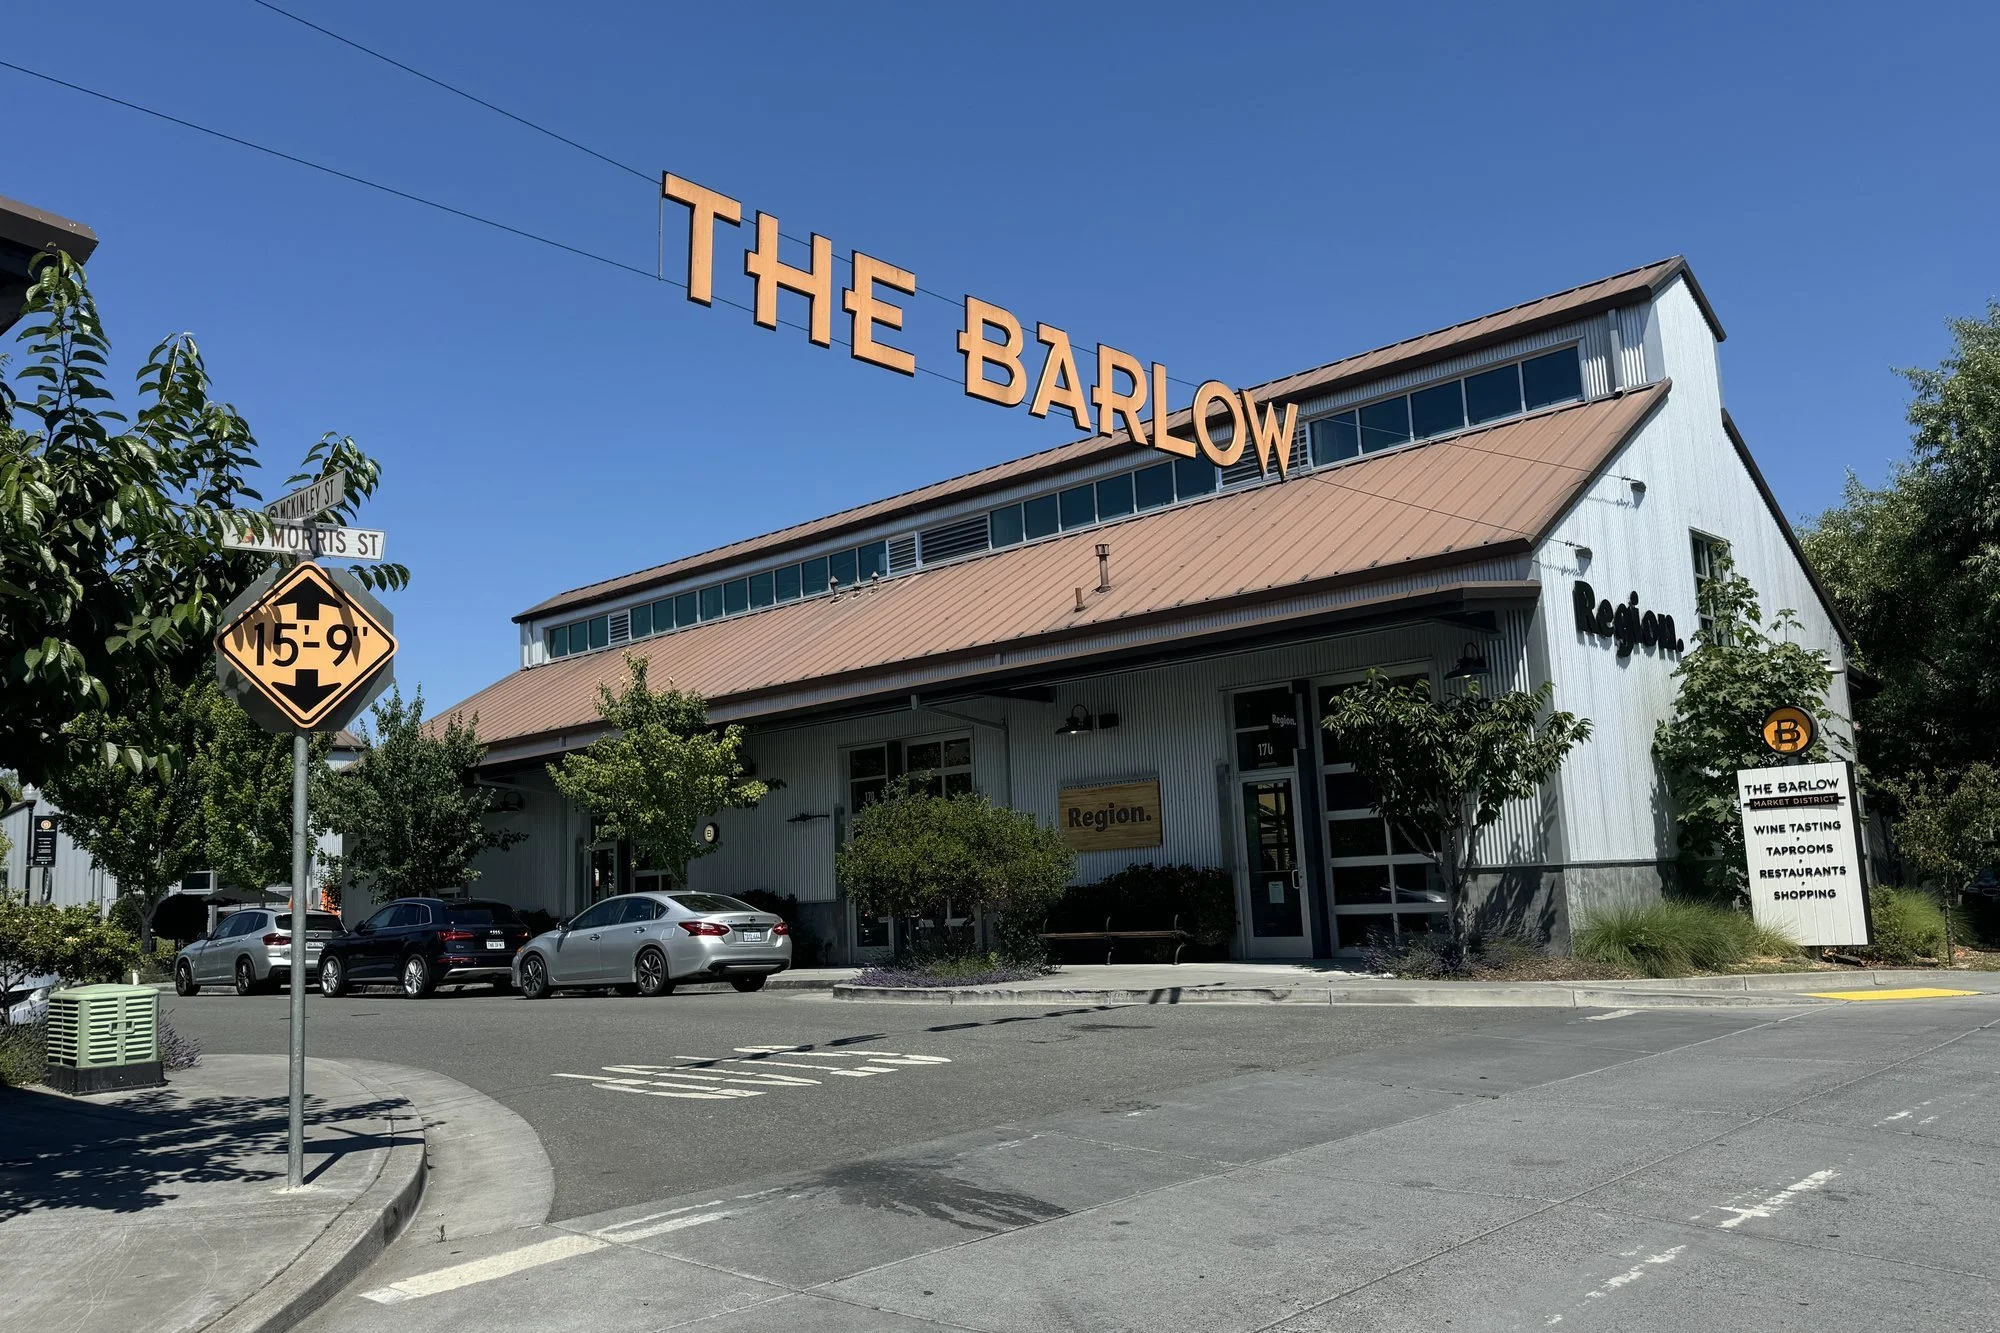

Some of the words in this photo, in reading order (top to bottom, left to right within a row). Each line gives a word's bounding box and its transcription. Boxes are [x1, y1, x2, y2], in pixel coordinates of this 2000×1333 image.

[662, 170, 916, 377] THE
[957, 294, 1299, 482] BARLOW
[281, 487, 321, 520] MCKINLEY
[325, 479, 335, 505] ST
[271, 525, 347, 554] MORRIS
[358, 533, 379, 556] ST
[1573, 580, 1684, 658] Region.
[1271, 713, 1297, 727] Region.
[1774, 719, 1801, 743] B
[1744, 783, 1773, 796] THE
[1777, 778, 1839, 793] BARLOW
[1753, 798, 1790, 807] MARKET
[1793, 795, 1835, 805] DISTRICT
[1068, 802, 1152, 832] Region.
[1754, 824, 1786, 835] WINE
[1789, 821, 1842, 833] TASTING
[1766, 844, 1834, 856] TAPROOMS
[1759, 866, 1847, 879] RESTAURANTS
[1773, 889, 1837, 901] SHOPPING
